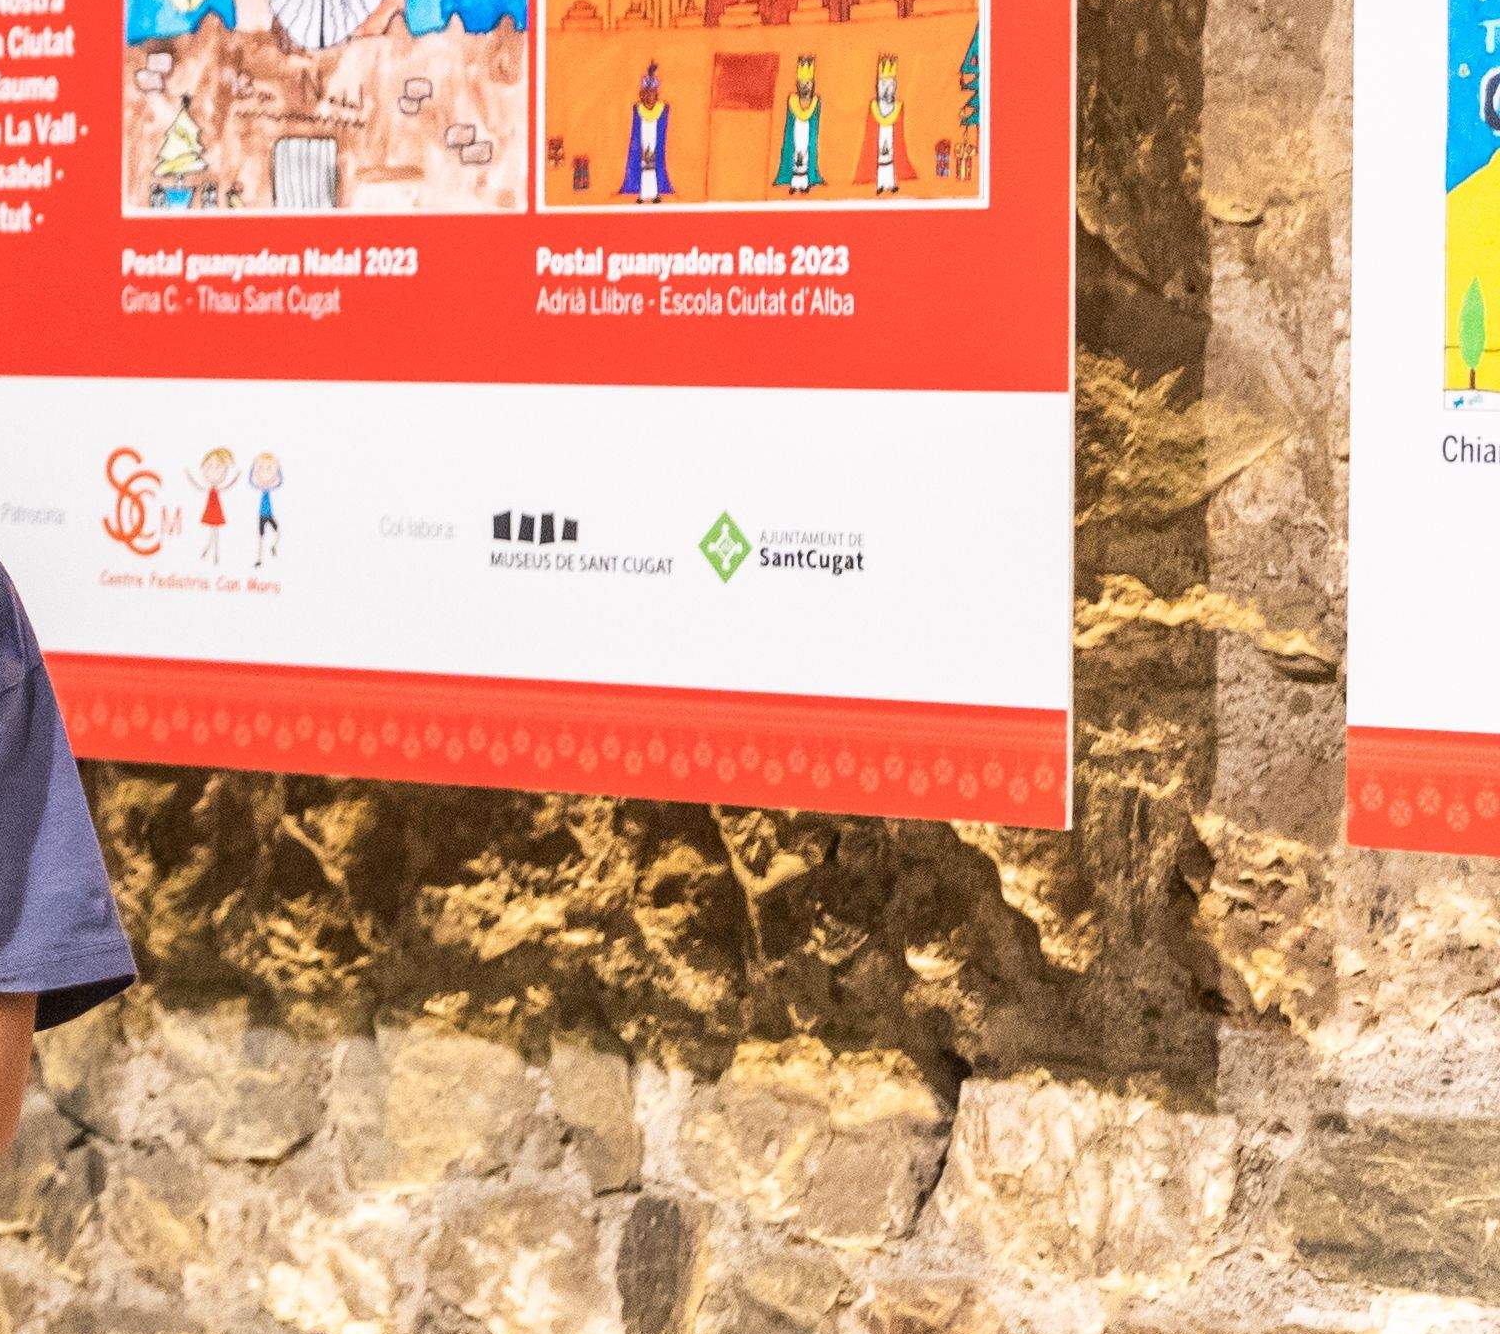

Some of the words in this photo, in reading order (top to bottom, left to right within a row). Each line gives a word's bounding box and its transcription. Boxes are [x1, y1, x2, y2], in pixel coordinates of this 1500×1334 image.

[7, 25, 76, 58] Ciutat
[4, 114, 31, 145] La
[34, 112, 76, 145] Vall
[121, 247, 180, 278] Postal
[185, 251, 300, 282] guanyadora
[304, 248, 361, 276] Nadal
[365, 248, 419, 276] 2023
[536, 246, 603, 276] Postal
[606, 249, 733, 282] guanyadora
[737, 247, 787, 275] Reis
[791, 246, 849, 275] 2023
[121, 286, 160, 313] Gina
[196, 286, 240, 314] Thau
[243, 287, 285, 315] Sant
[288, 287, 341, 320] Cugat
[536, 285, 587, 315] Adrià
[589, 285, 645, 315] Llibre
[659, 287, 722, 316] Escola
[725, 287, 787, 316] Ciutat
[791, 287, 855, 316] d'Alba
[759, 532, 843, 546] AJUNTAMENT
[848, 533, 864, 546] DE
[490, 550, 551, 569] MUSEUS
[555, 554, 576, 571] DE
[579, 555, 618, 573] SANT
[622, 556, 673, 575] CUGAT
[759, 548, 864, 576] SantCugat
[99, 570, 144, 588] Centre
[217, 575, 240, 591] Can
